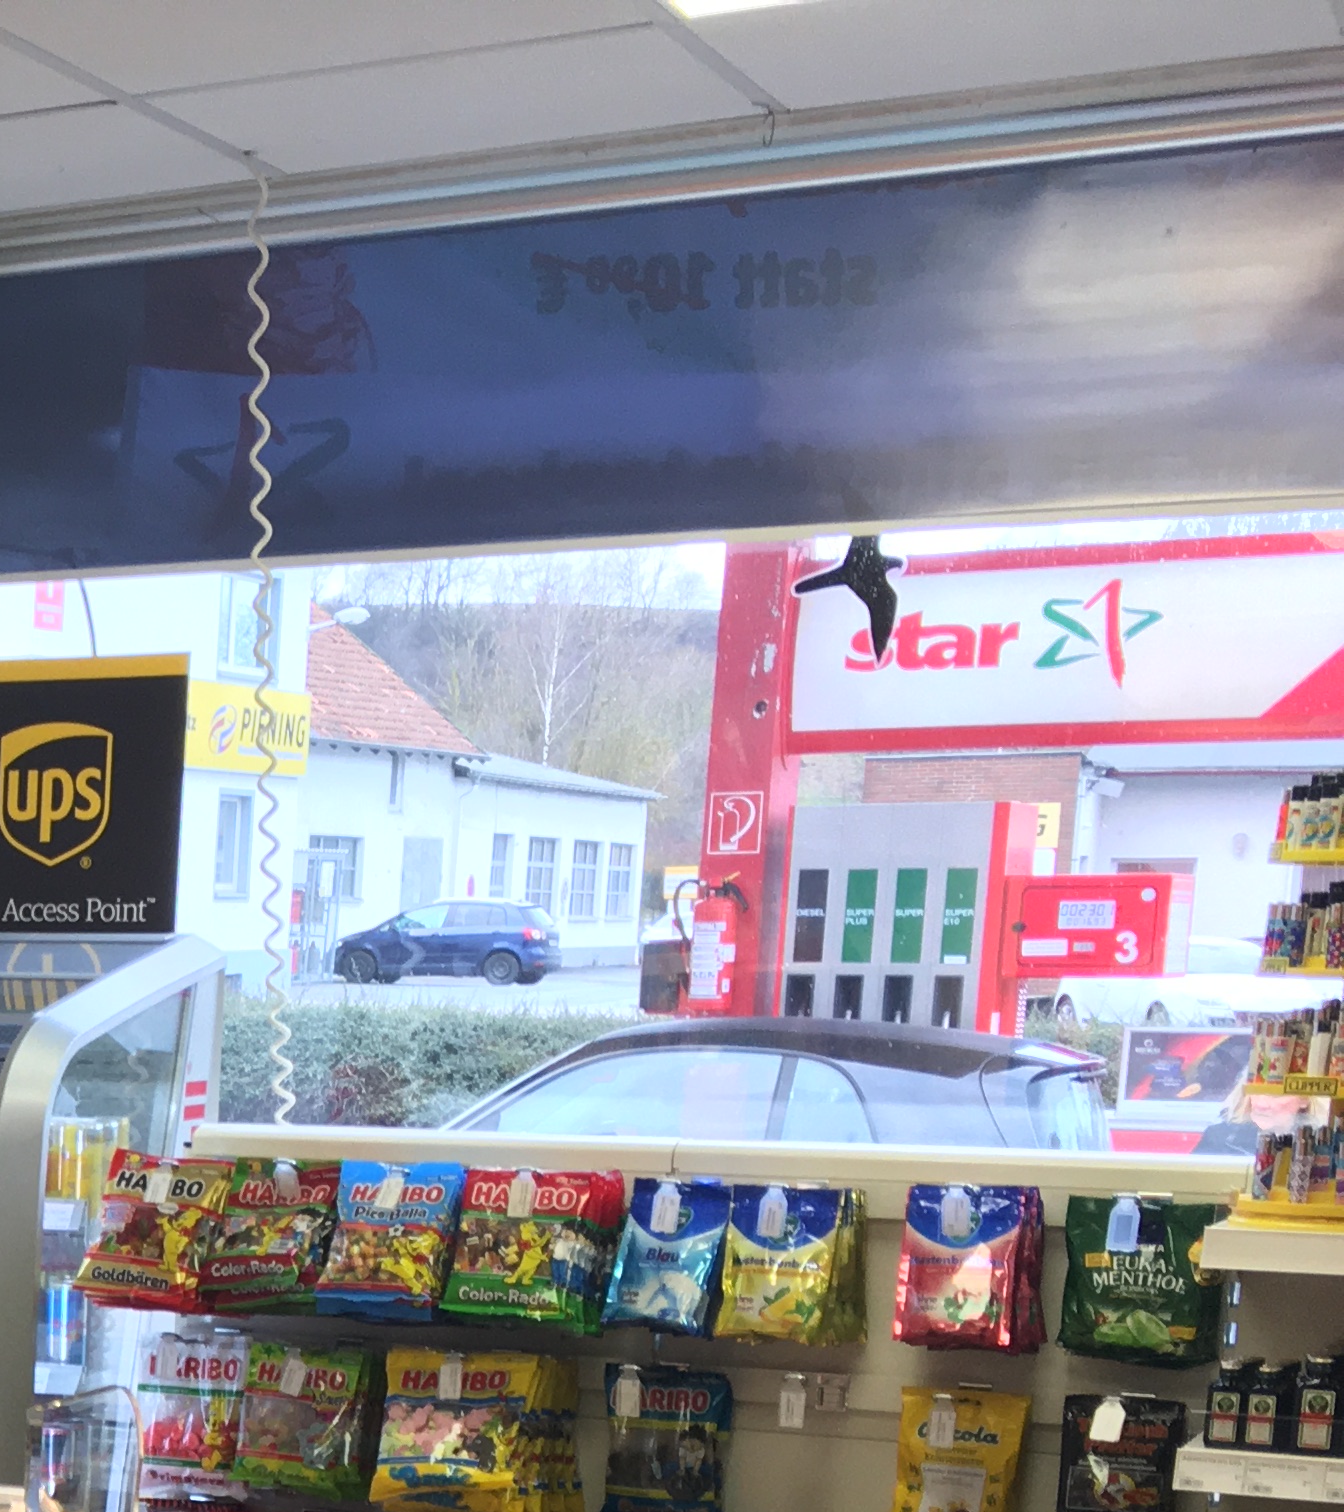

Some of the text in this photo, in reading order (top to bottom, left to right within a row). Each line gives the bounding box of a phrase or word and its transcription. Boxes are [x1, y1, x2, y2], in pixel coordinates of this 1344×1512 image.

[843, 609, 1021, 672] star
[7, 767, 102, 843] ups
[1, 898, 80, 923] Access
[796, 908, 825, 917] DIESEL
[846, 909, 874, 917] SUPER
[895, 909, 924, 917] SUPER
[945, 909, 974, 917] SUPER
[845, 918, 868, 926] PLUS
[944, 918, 960, 926] E10
[1114, 930, 1139, 965] 3
[644, 1246, 681, 1264] Blau
[92, 1266, 169, 1290] Goldbären
[1092, 1270, 1186, 1295] MENTHOL
